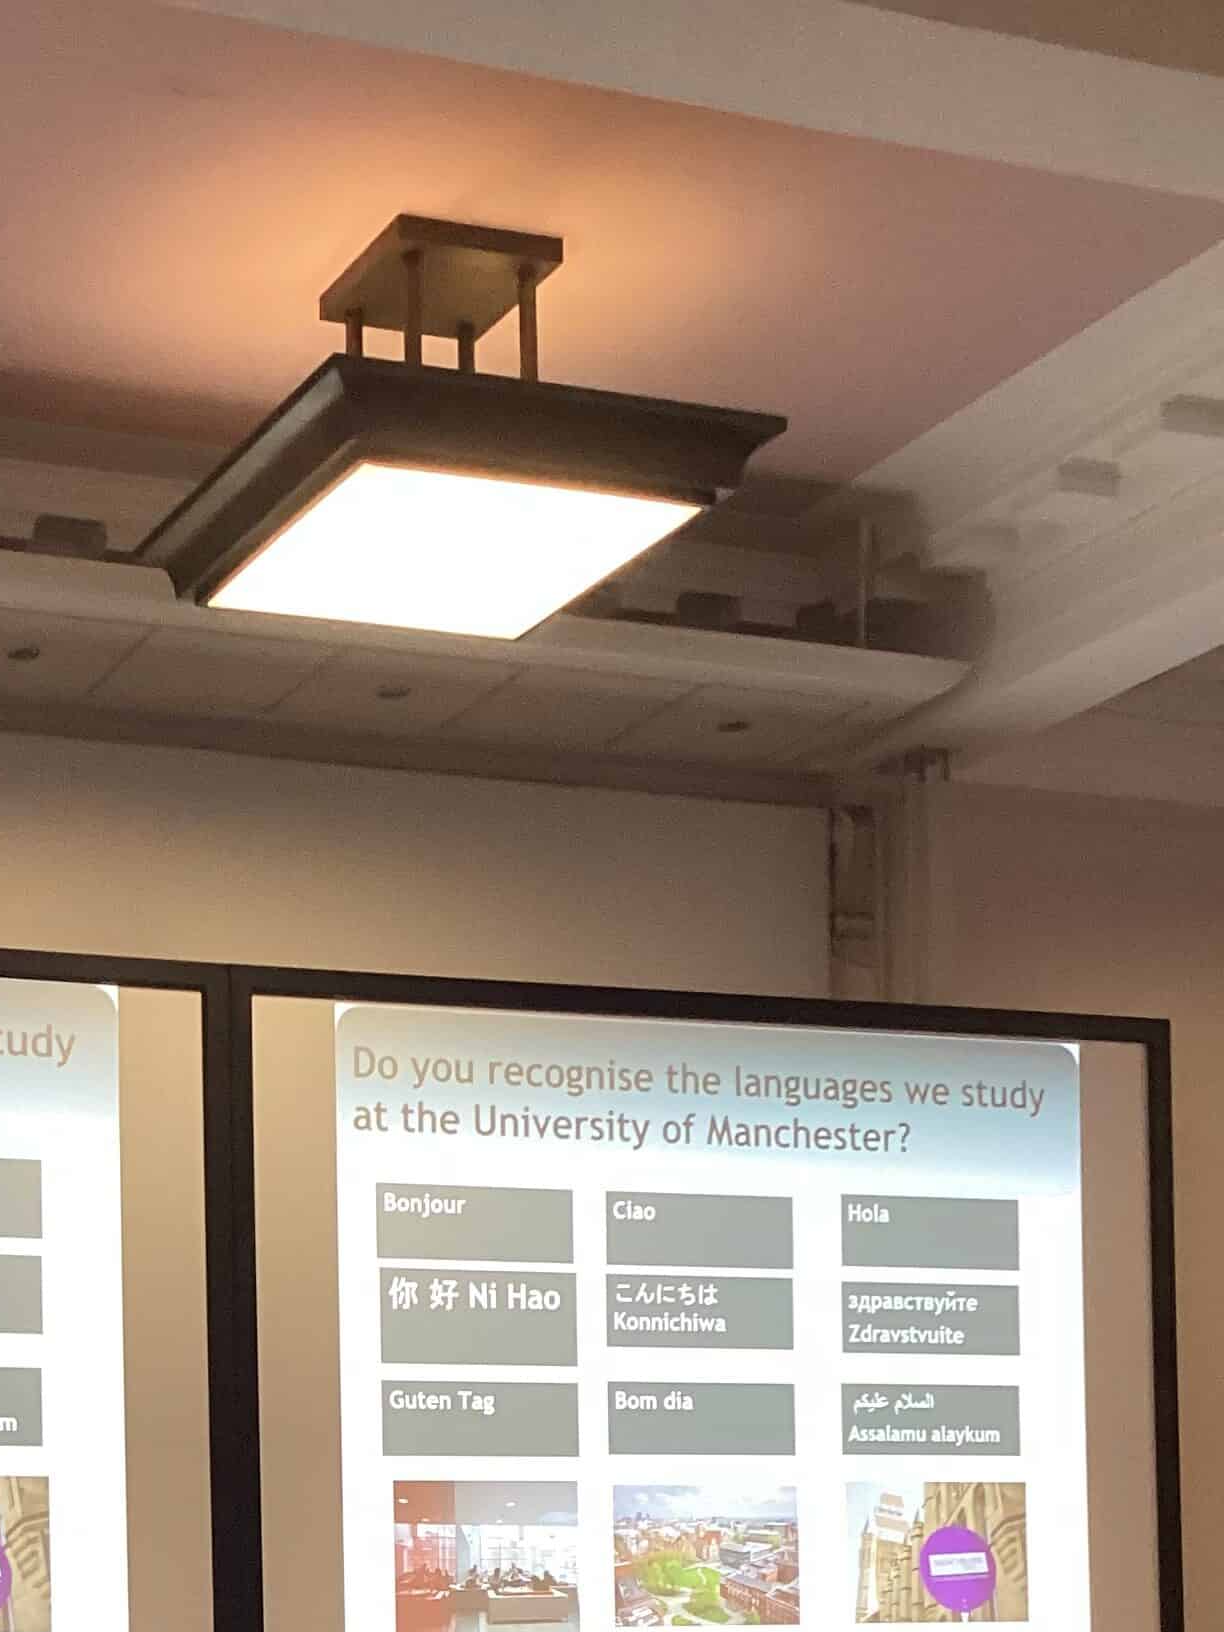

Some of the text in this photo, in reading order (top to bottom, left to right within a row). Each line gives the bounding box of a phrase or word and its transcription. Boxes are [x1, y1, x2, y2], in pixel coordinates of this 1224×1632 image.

[353, 1046, 1044, 1117] Do you recognise the languages we study
[353, 1101, 911, 1154] at the University of Manchester?
[383, 1192, 466, 1218] Bonjour
[612, 1200, 656, 1221] Ciao
[848, 1204, 889, 1223] Hola
[469, 1281, 497, 1310] Ni
[507, 1284, 561, 1311] Hao
[615, 1283, 719, 1305] こんにちは
[849, 1290, 978, 1314] здравствуйте
[613, 1312, 726, 1332] Konnichiwa
[849, 1324, 965, 1344] Zdravstvuite
[389, 1390, 495, 1415] Guten Tag
[615, 1391, 693, 1410] Bom dia
[849, 1425, 1000, 1446] Assalamu alaykum
